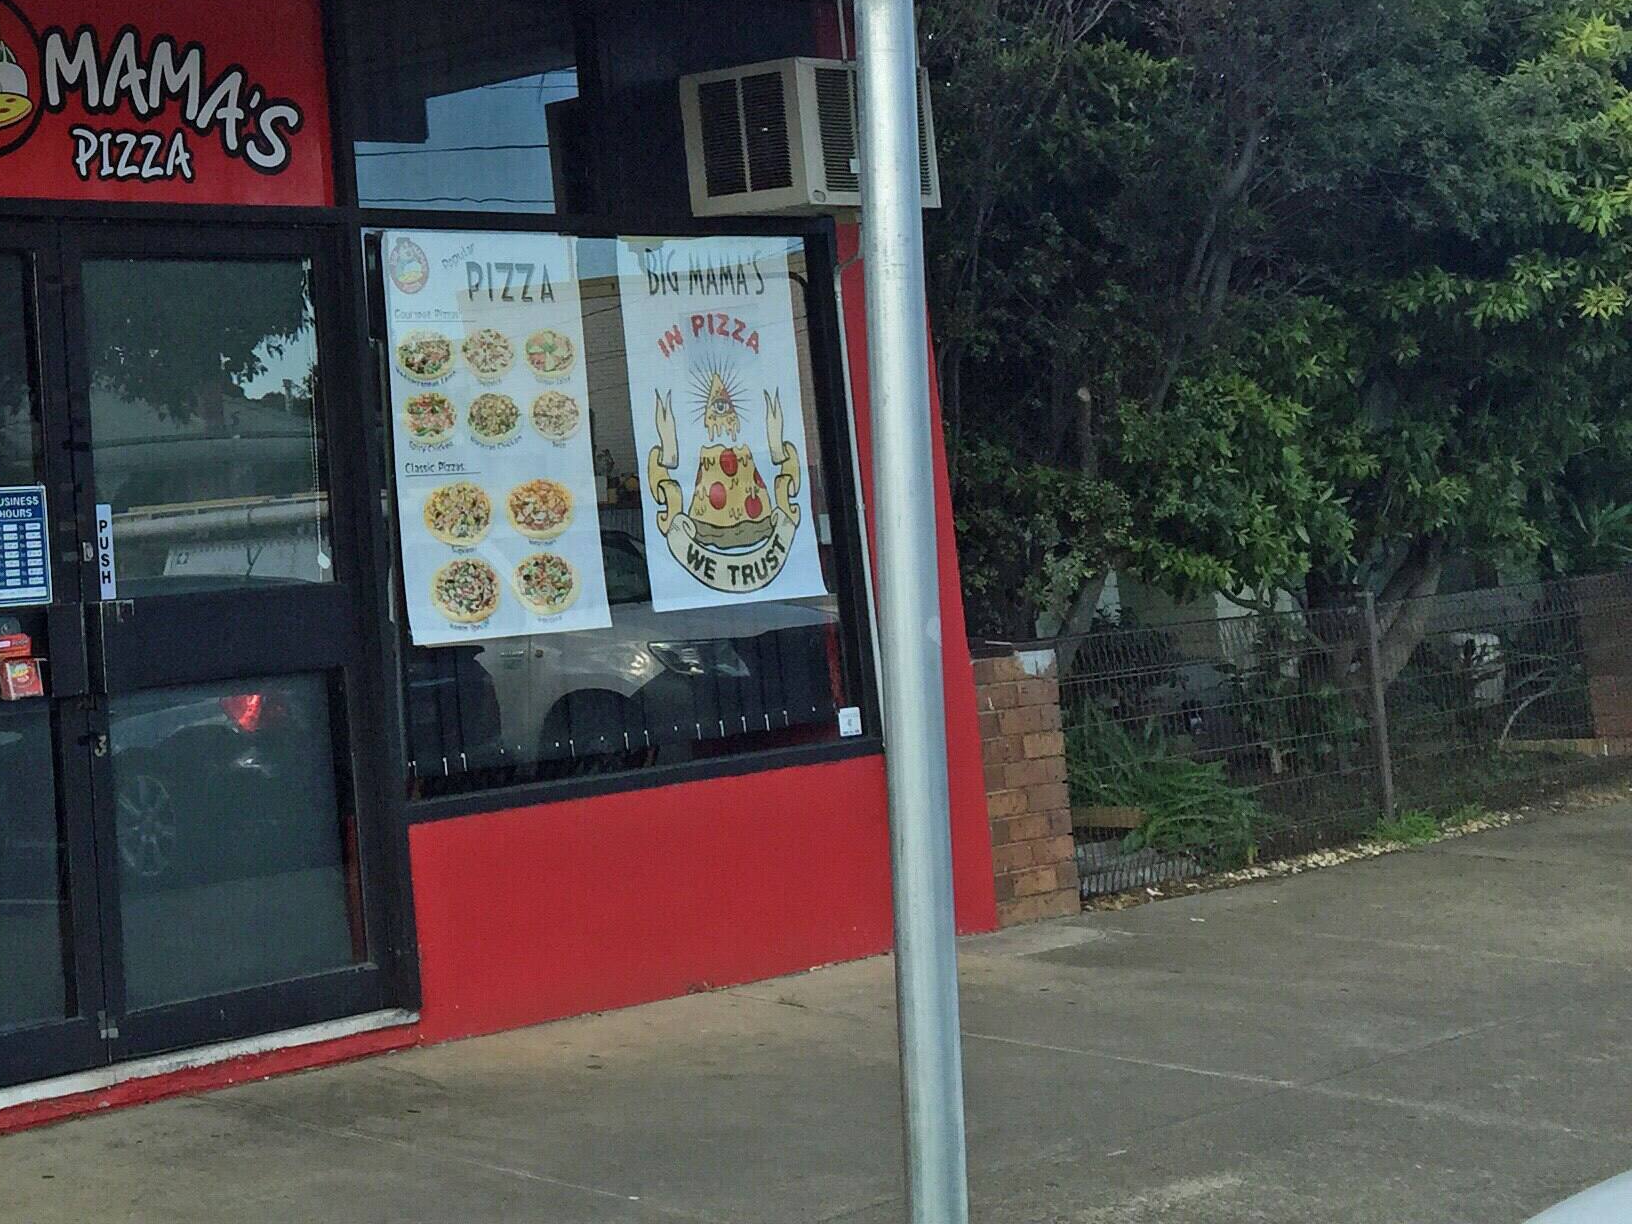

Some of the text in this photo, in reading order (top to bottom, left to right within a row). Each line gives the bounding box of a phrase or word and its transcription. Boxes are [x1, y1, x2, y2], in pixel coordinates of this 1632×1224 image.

[40, 25, 303, 175] MAMA'S
[70, 126, 195, 183] PIZZA
[466, 261, 556, 303] PIZZA
[645, 248, 764, 295] BIG MAMA'S
[658, 313, 759, 358] IN PIZZA
[405, 461, 465, 474] Classic Pizzas
[99, 520, 112, 585] PUSH
[687, 533, 785, 585] WE TRUST
